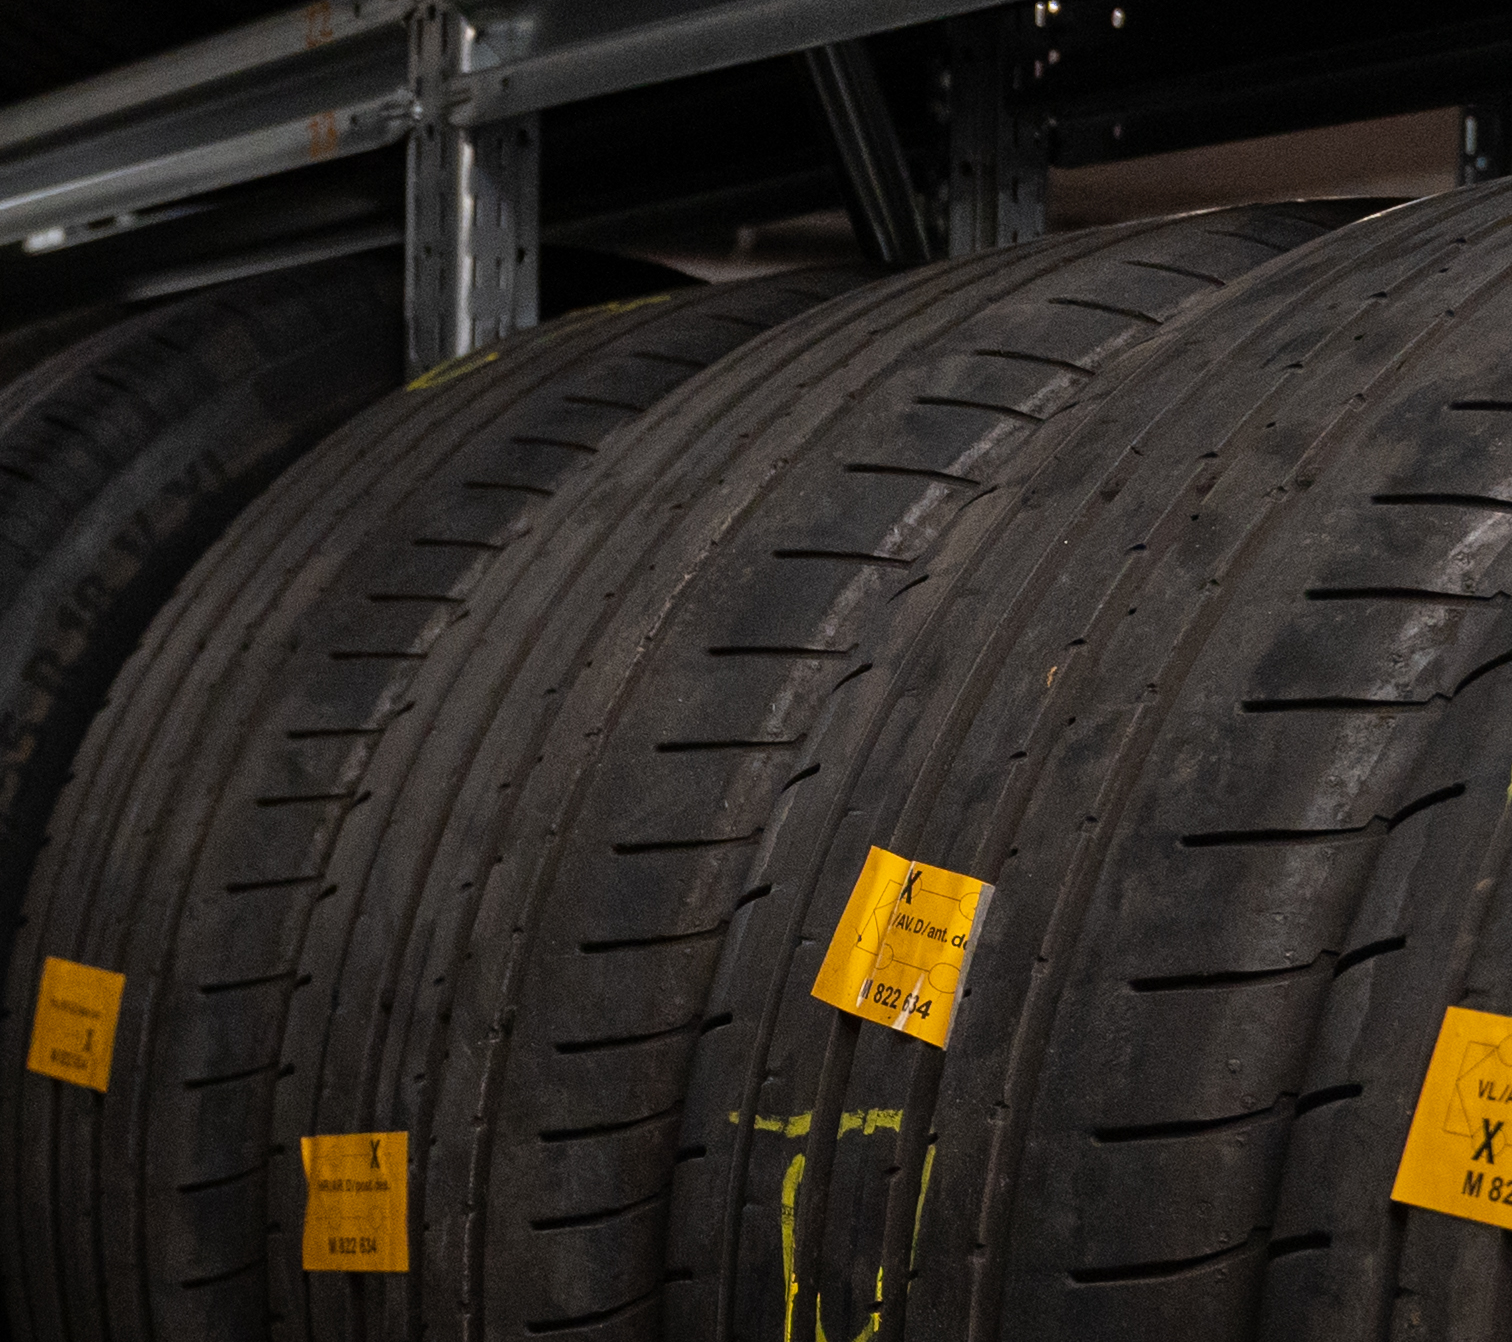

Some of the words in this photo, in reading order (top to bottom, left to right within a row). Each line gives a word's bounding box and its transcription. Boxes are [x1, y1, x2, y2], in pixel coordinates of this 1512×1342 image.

[899, 868, 922, 905] X
[873, 983, 901, 1010] 822
[901, 993, 932, 1020] 634
[1472, 1118, 1505, 1165] X
[1461, 1170, 1483, 1198] M
